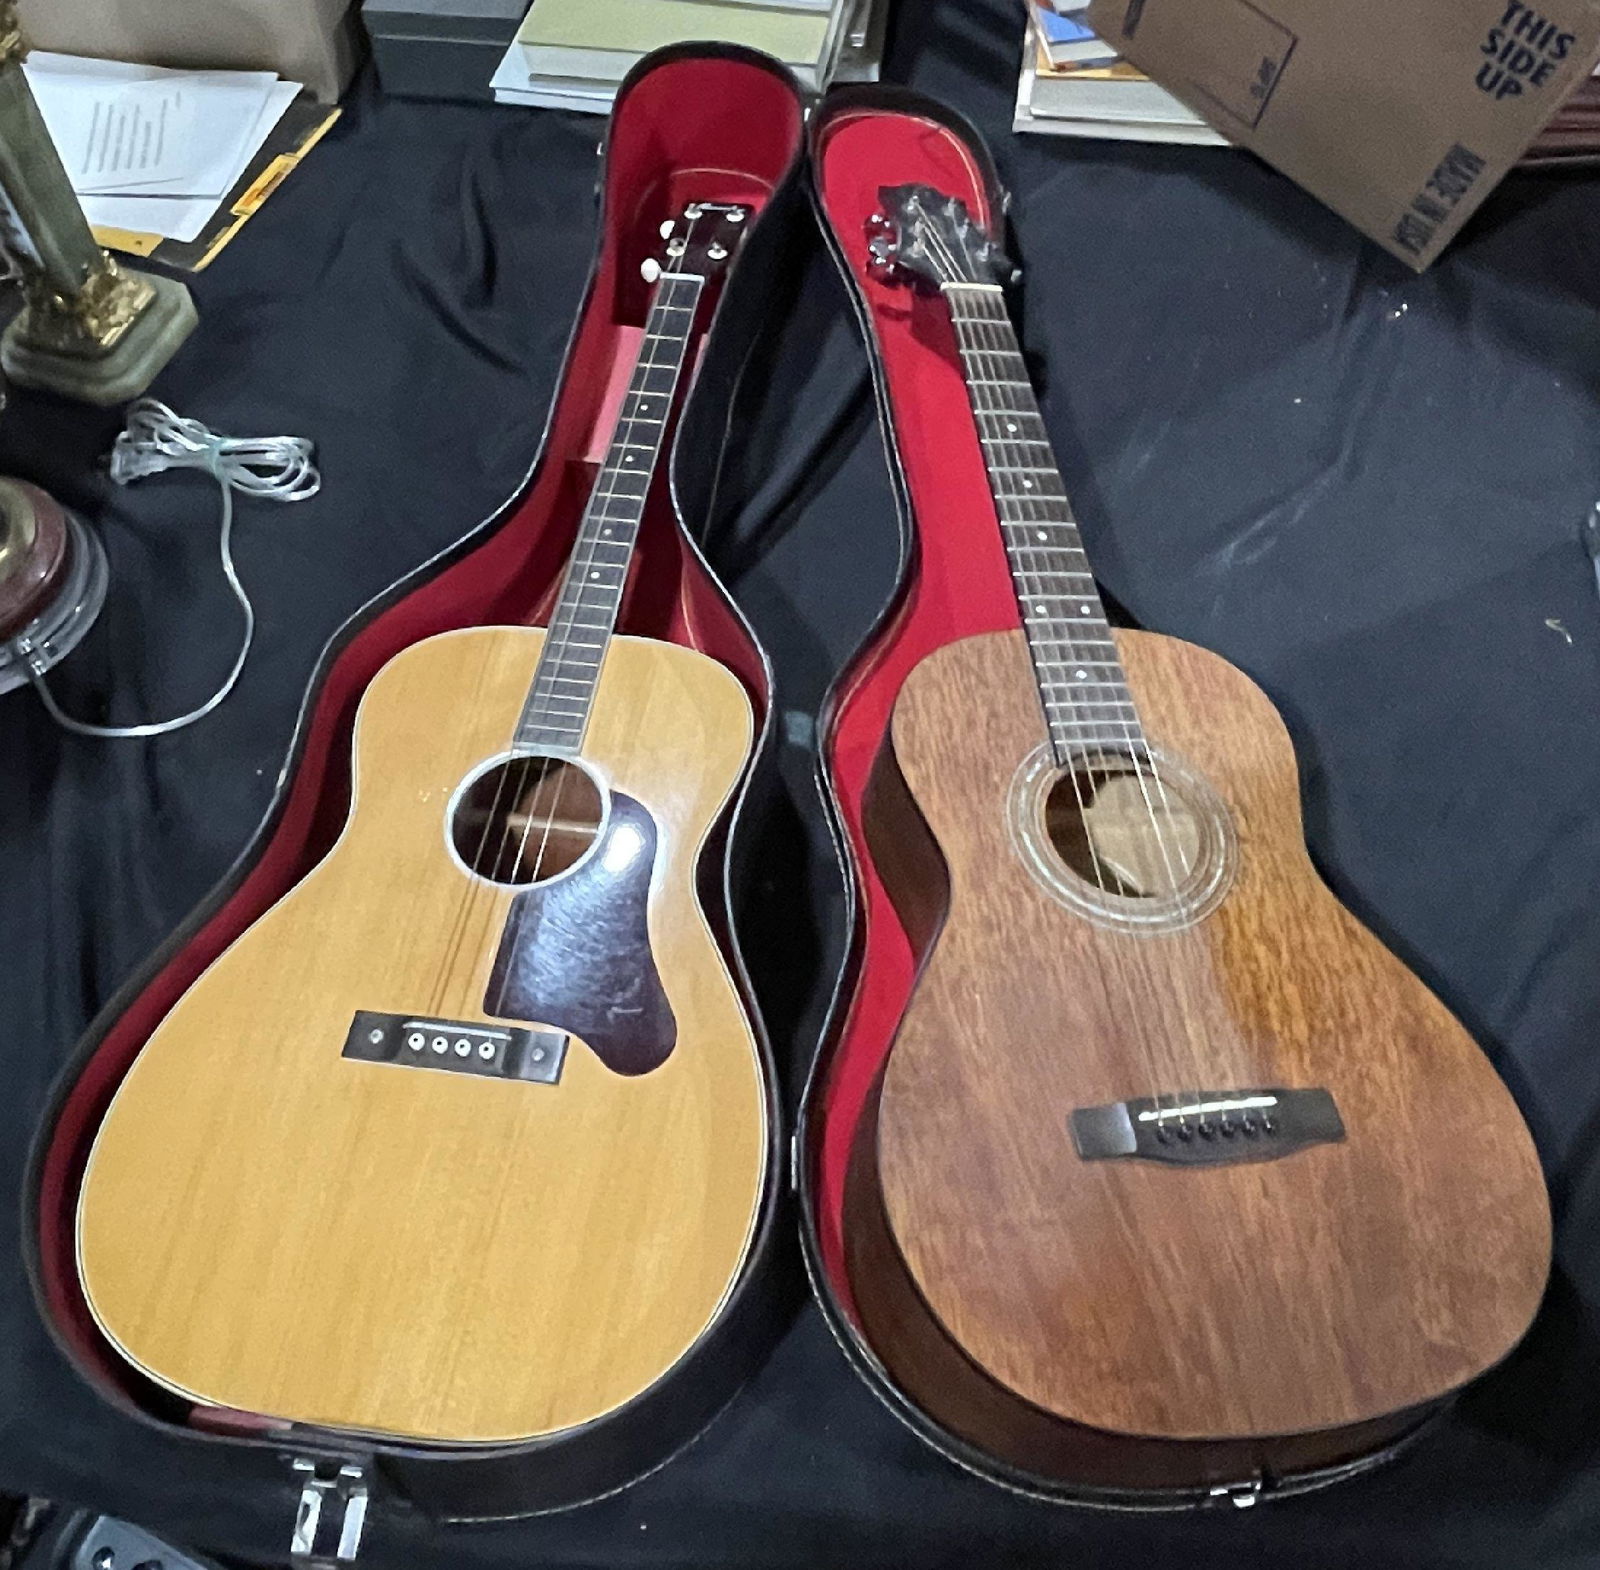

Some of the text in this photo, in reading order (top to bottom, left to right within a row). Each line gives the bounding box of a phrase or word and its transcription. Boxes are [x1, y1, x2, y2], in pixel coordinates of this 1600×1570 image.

[1480, 28, 1556, 87] SIDE
[1502, 0, 1575, 59] THIS
[1475, 62, 1522, 100] UP
